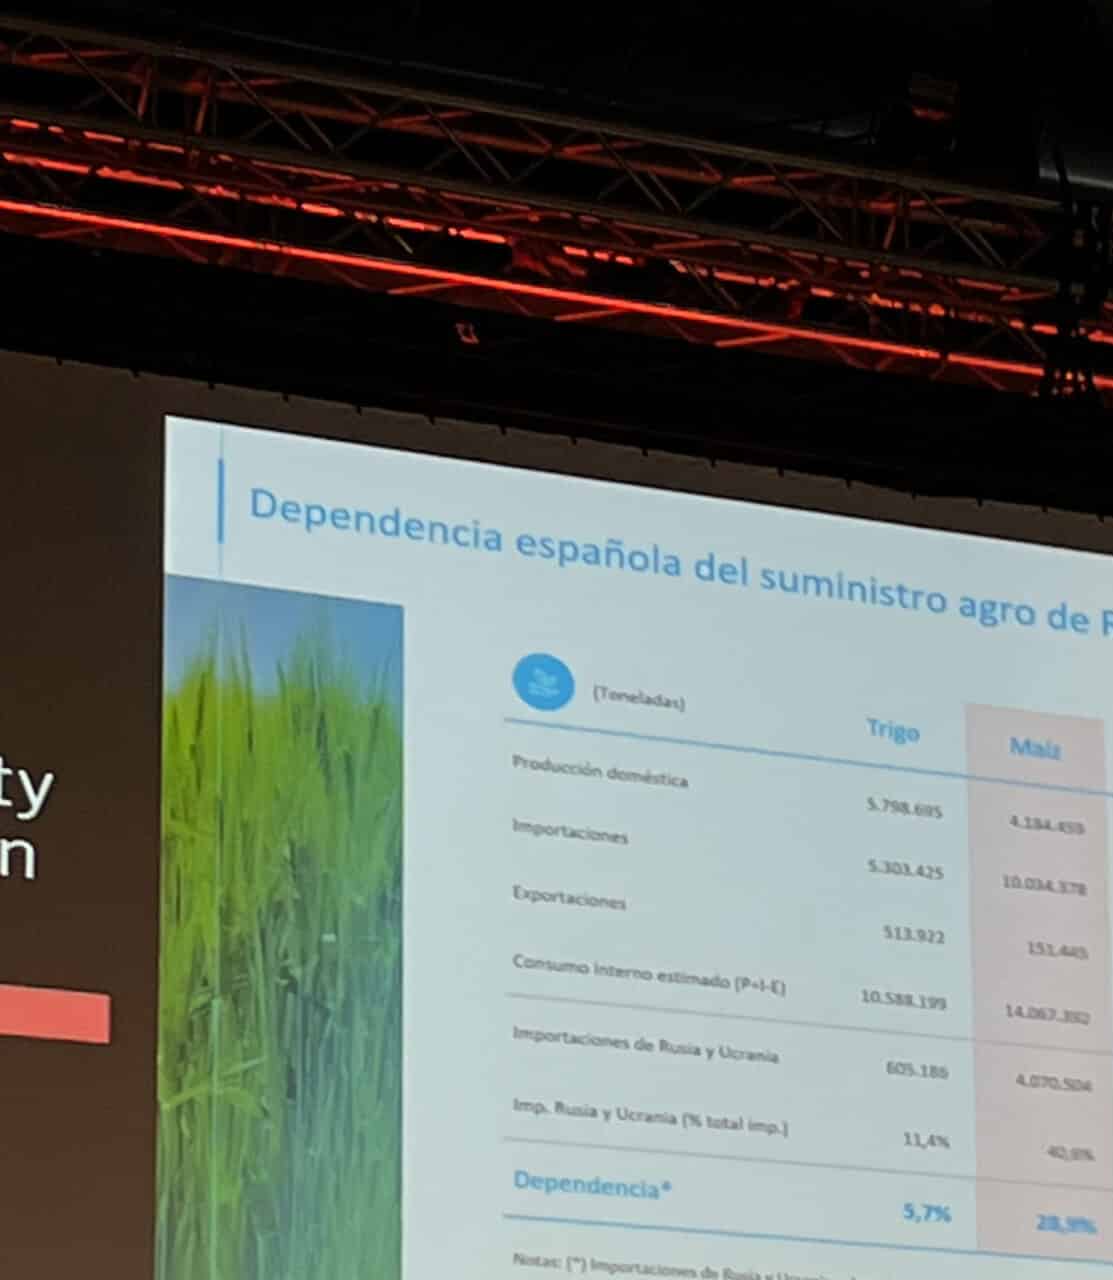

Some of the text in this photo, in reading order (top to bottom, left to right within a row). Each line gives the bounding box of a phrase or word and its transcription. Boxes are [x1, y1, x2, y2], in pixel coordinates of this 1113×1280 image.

[250, 487, 502, 552] Dependencia
[516, 534, 681, 578] española
[694, 551, 748, 587] del
[760, 566, 947, 614] suministro
[958, 593, 1036, 628] agro
[1048, 602, 1090, 634] de
[592, 685, 686, 712] (Toneladas)
[866, 717, 921, 745] Trigo
[511, 754, 689, 789] Producción doméstica
[511, 818, 629, 846] Importaciones
[511, 884, 627, 912] Exportaciones
[512, 953, 590, 976] Consumo
[593, 962, 653, 982] interno
[657, 970, 731, 990] estimado
[512, 1025, 780, 1065] Importaciones de Rusia y Ucrania
[512, 1098, 789, 1138] Imp. Rusia y Ucrania (% total imp.)
[903, 1131, 950, 1151] 11,4%
[903, 1202, 953, 1225] 5,7%
[590, 1257, 697, 1280] Importaciones
[700, 1265, 719, 1280] de
